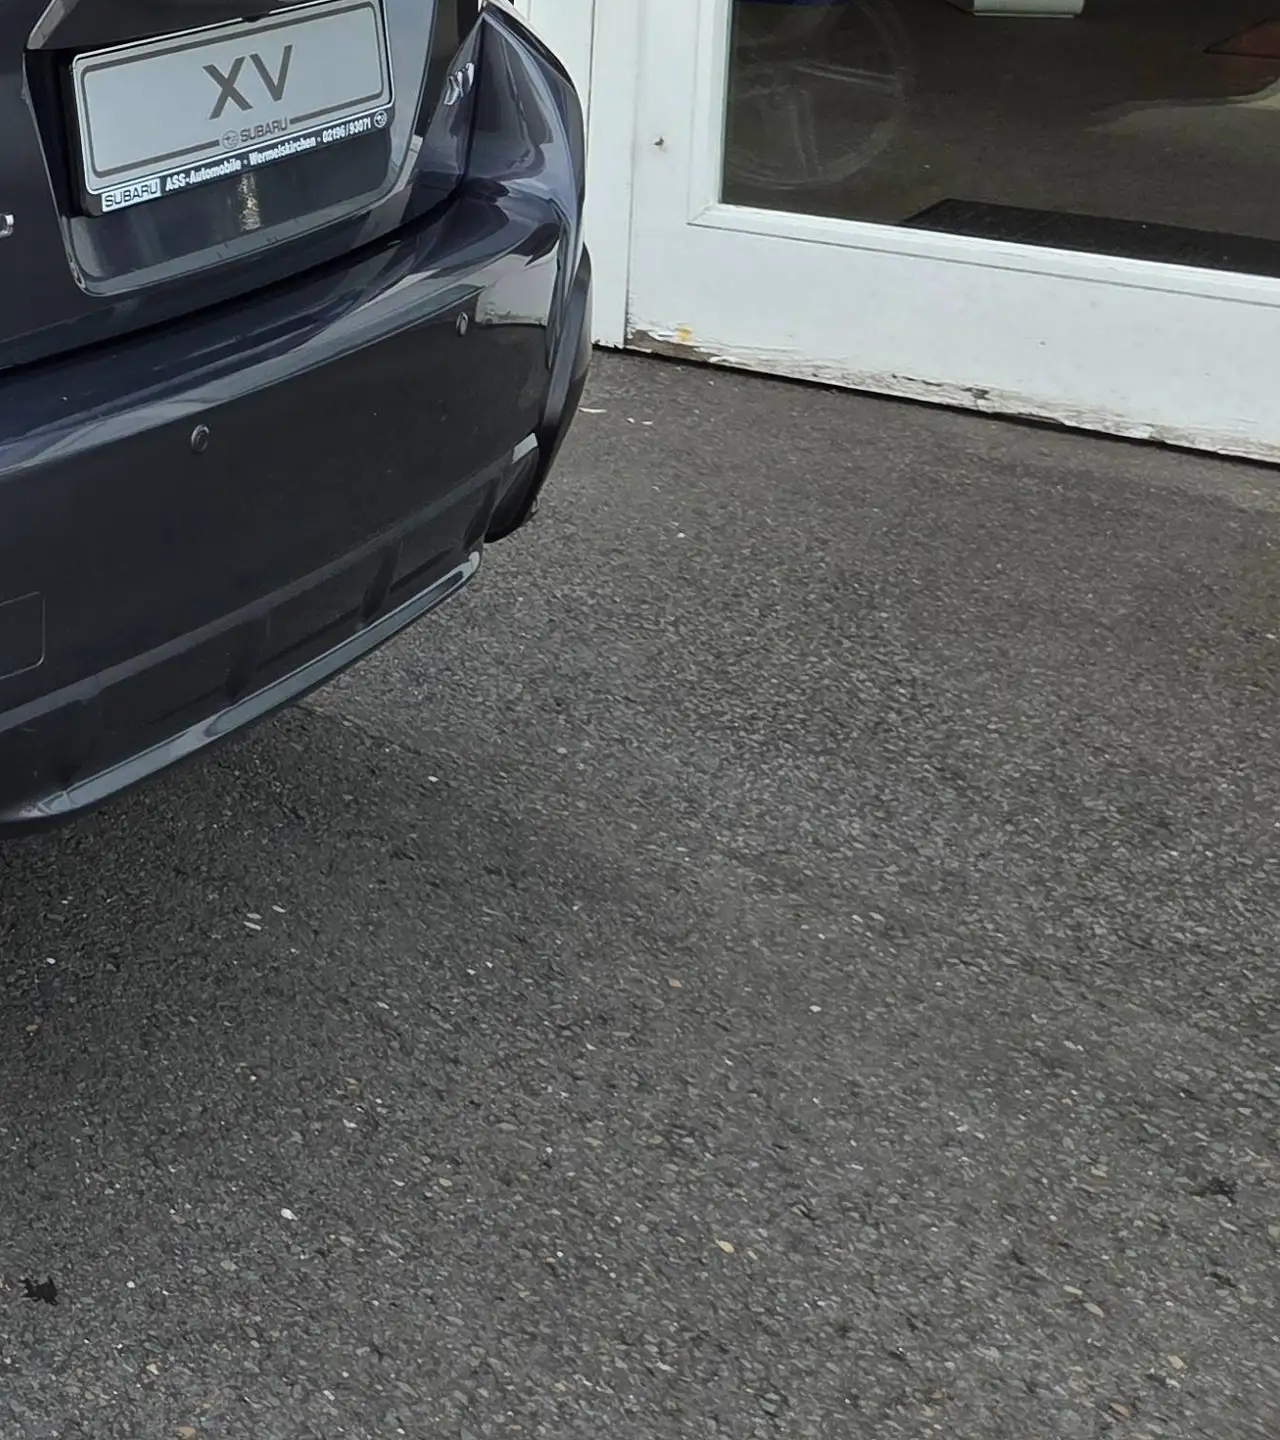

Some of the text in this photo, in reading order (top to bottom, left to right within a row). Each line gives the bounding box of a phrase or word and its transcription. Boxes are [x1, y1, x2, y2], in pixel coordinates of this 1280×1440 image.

[204, 44, 293, 120] XV
[240, 116, 288, 143] SUBARU
[165, 157, 242, 192] ASS-Automobile
[248, 135, 317, 166] Wermelskirchen
[104, 178, 158, 208] SUBARU
